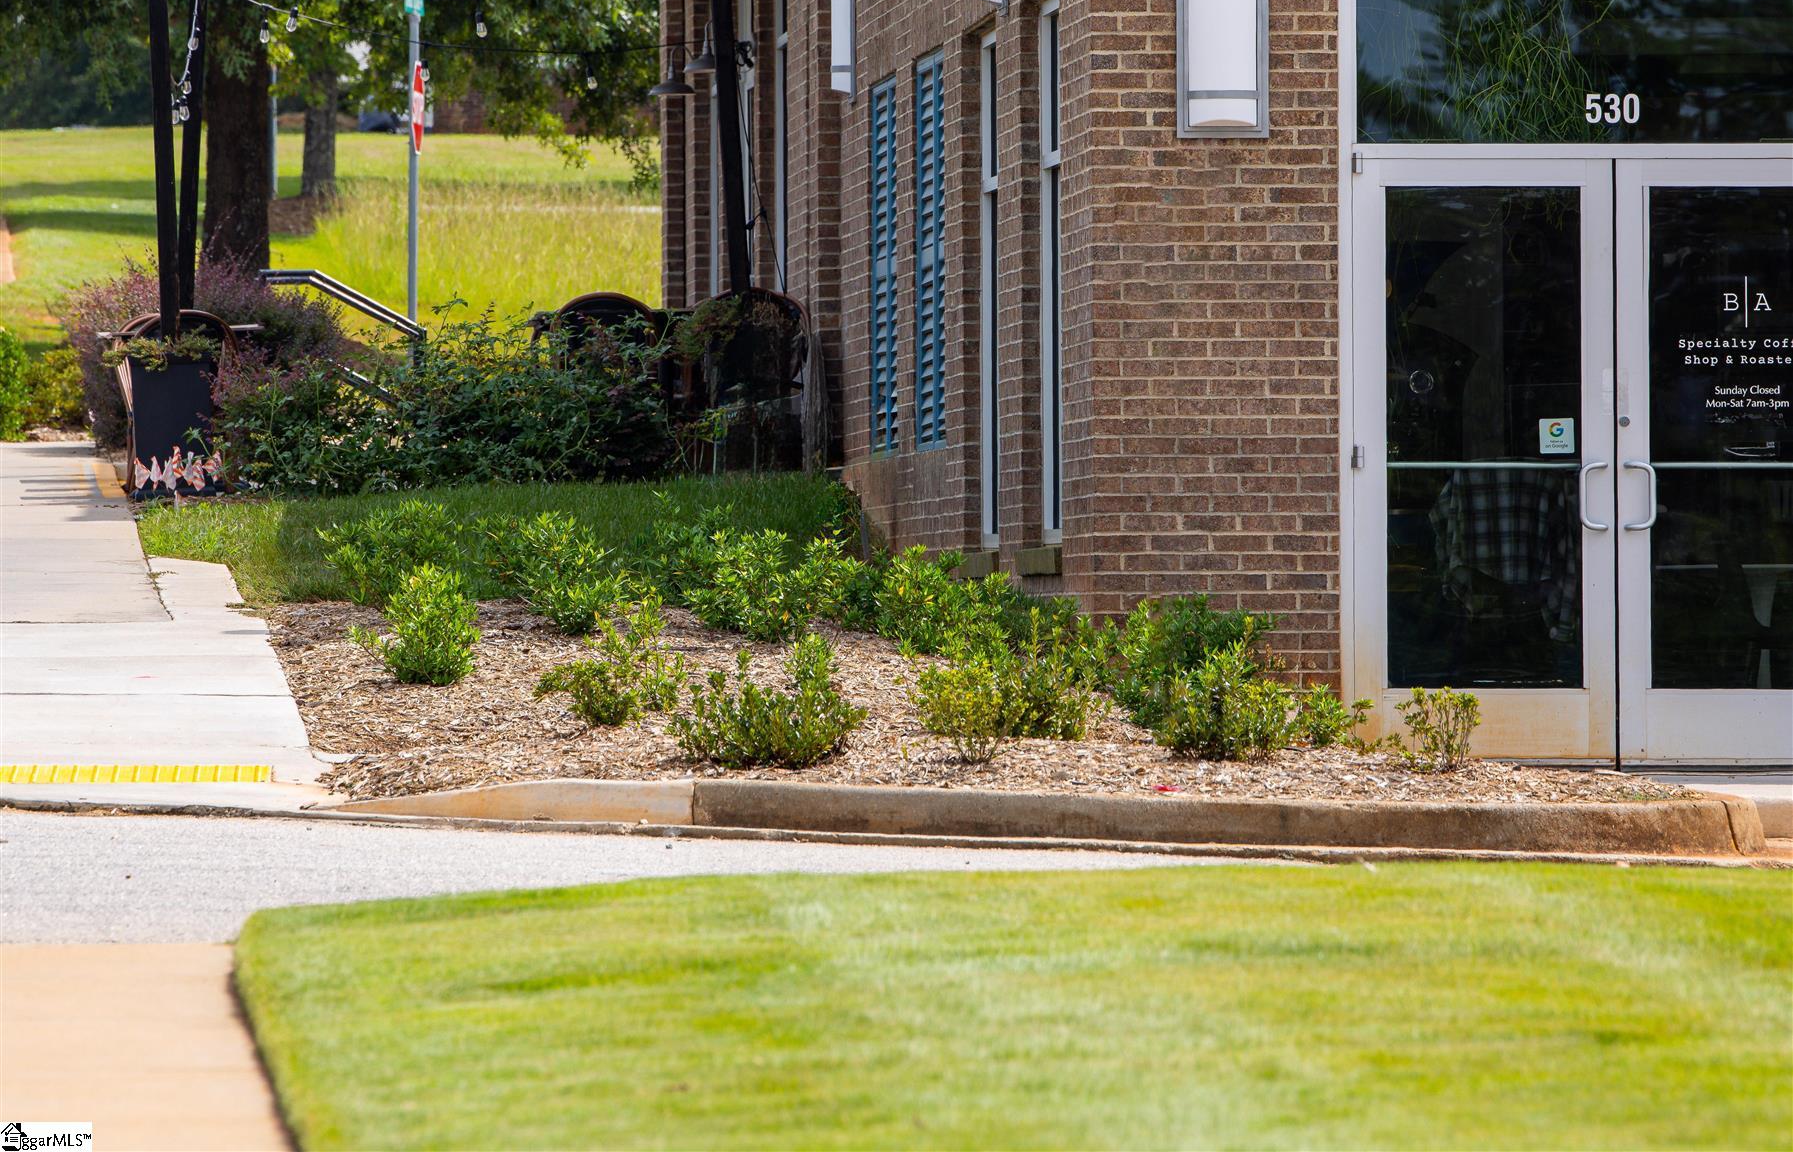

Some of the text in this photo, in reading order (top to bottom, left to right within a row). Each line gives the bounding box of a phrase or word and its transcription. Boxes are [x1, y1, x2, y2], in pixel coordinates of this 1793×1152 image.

[1585, 93, 1640, 124] 530
[1678, 338, 1757, 350] Specialty
[1684, 355, 1718, 366] Shop
[1725, 355, 1734, 364] &
[1714, 385, 1781, 397] Sunday Closed
[1705, 399, 1790, 410] Mon-Sat 7am-3pm
